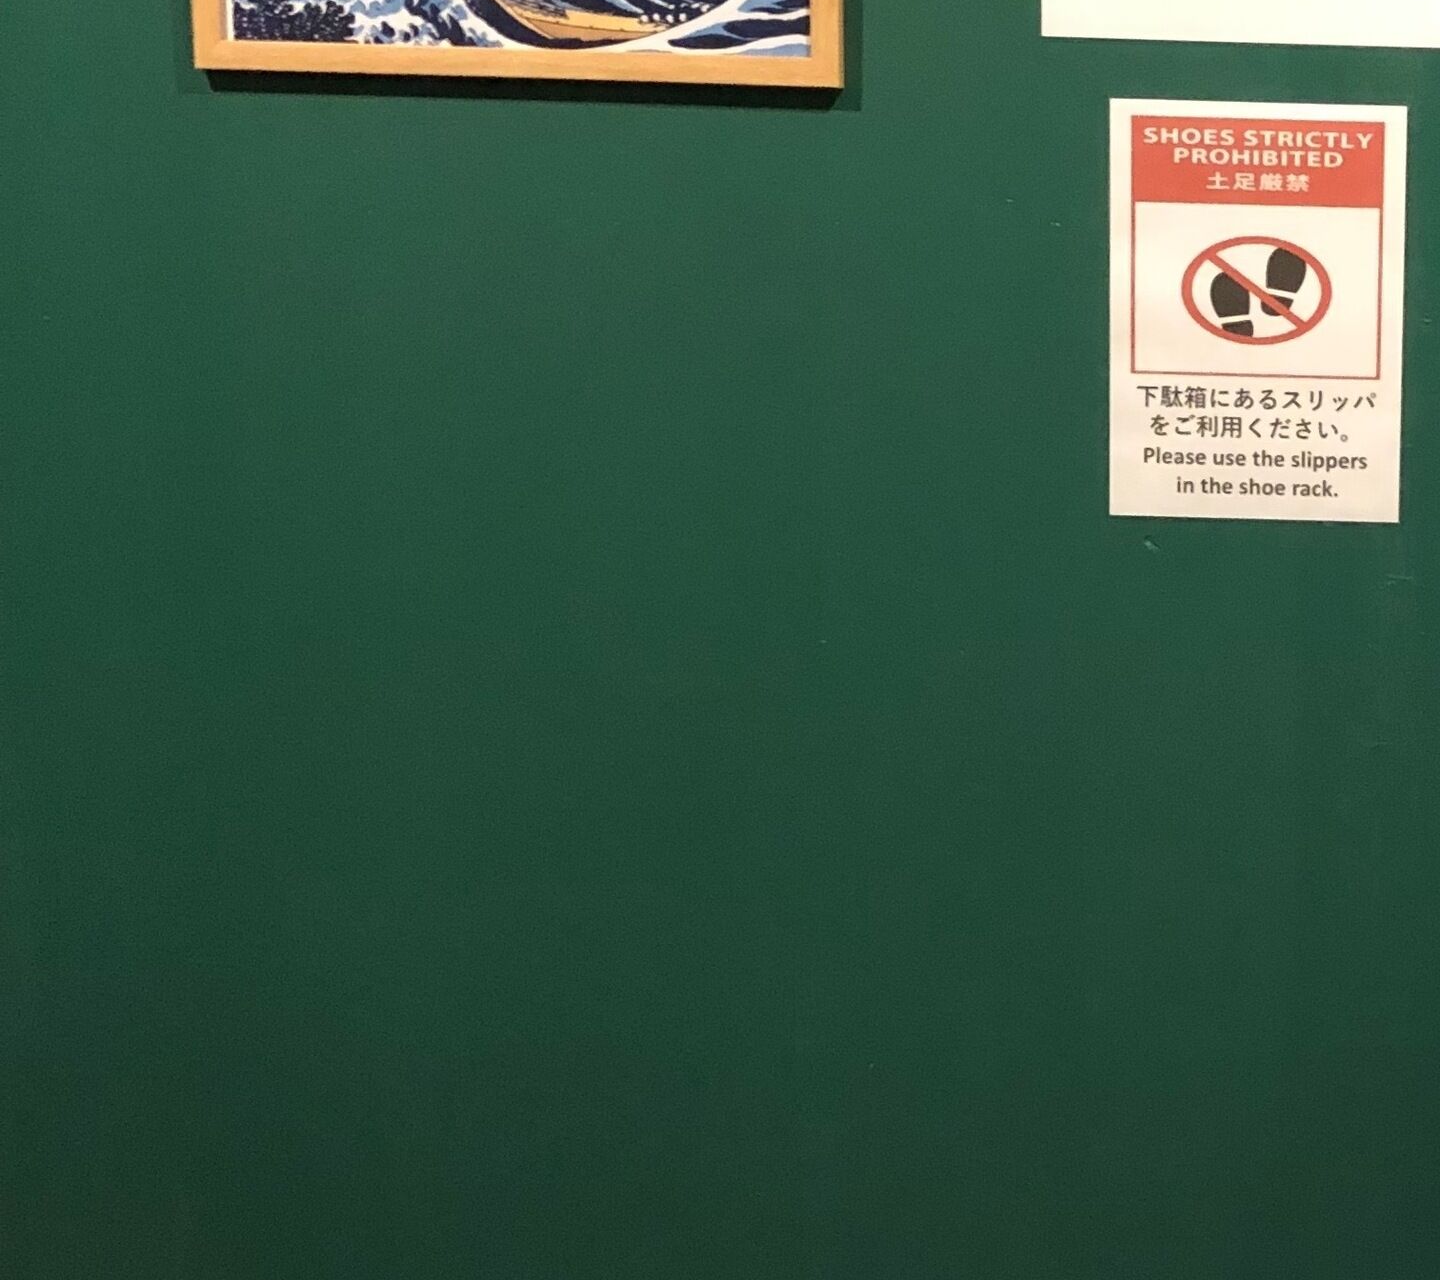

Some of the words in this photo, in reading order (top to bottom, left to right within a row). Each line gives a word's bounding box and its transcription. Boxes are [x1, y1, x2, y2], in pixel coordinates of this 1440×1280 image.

[1143, 126, 1236, 146] SHOES
[1243, 129, 1374, 150] STRICTLY
[1173, 146, 1344, 168] PROHIBITED
[1205, 171, 1311, 193] 土足厳禁
[1136, 384, 1377, 412] 下駄箱にあるスリッパ
[1149, 414, 1349, 443] をご利用ください。
[1143, 446, 1207, 466] Please
[1212, 450, 1247, 467] use
[1252, 449, 1285, 468] the
[1290, 450, 1368, 472] slippers
[1175, 476, 1195, 494] in
[1200, 476, 1233, 495] the
[1238, 477, 1286, 496] shoe
[1292, 479, 1339, 498] rack.
